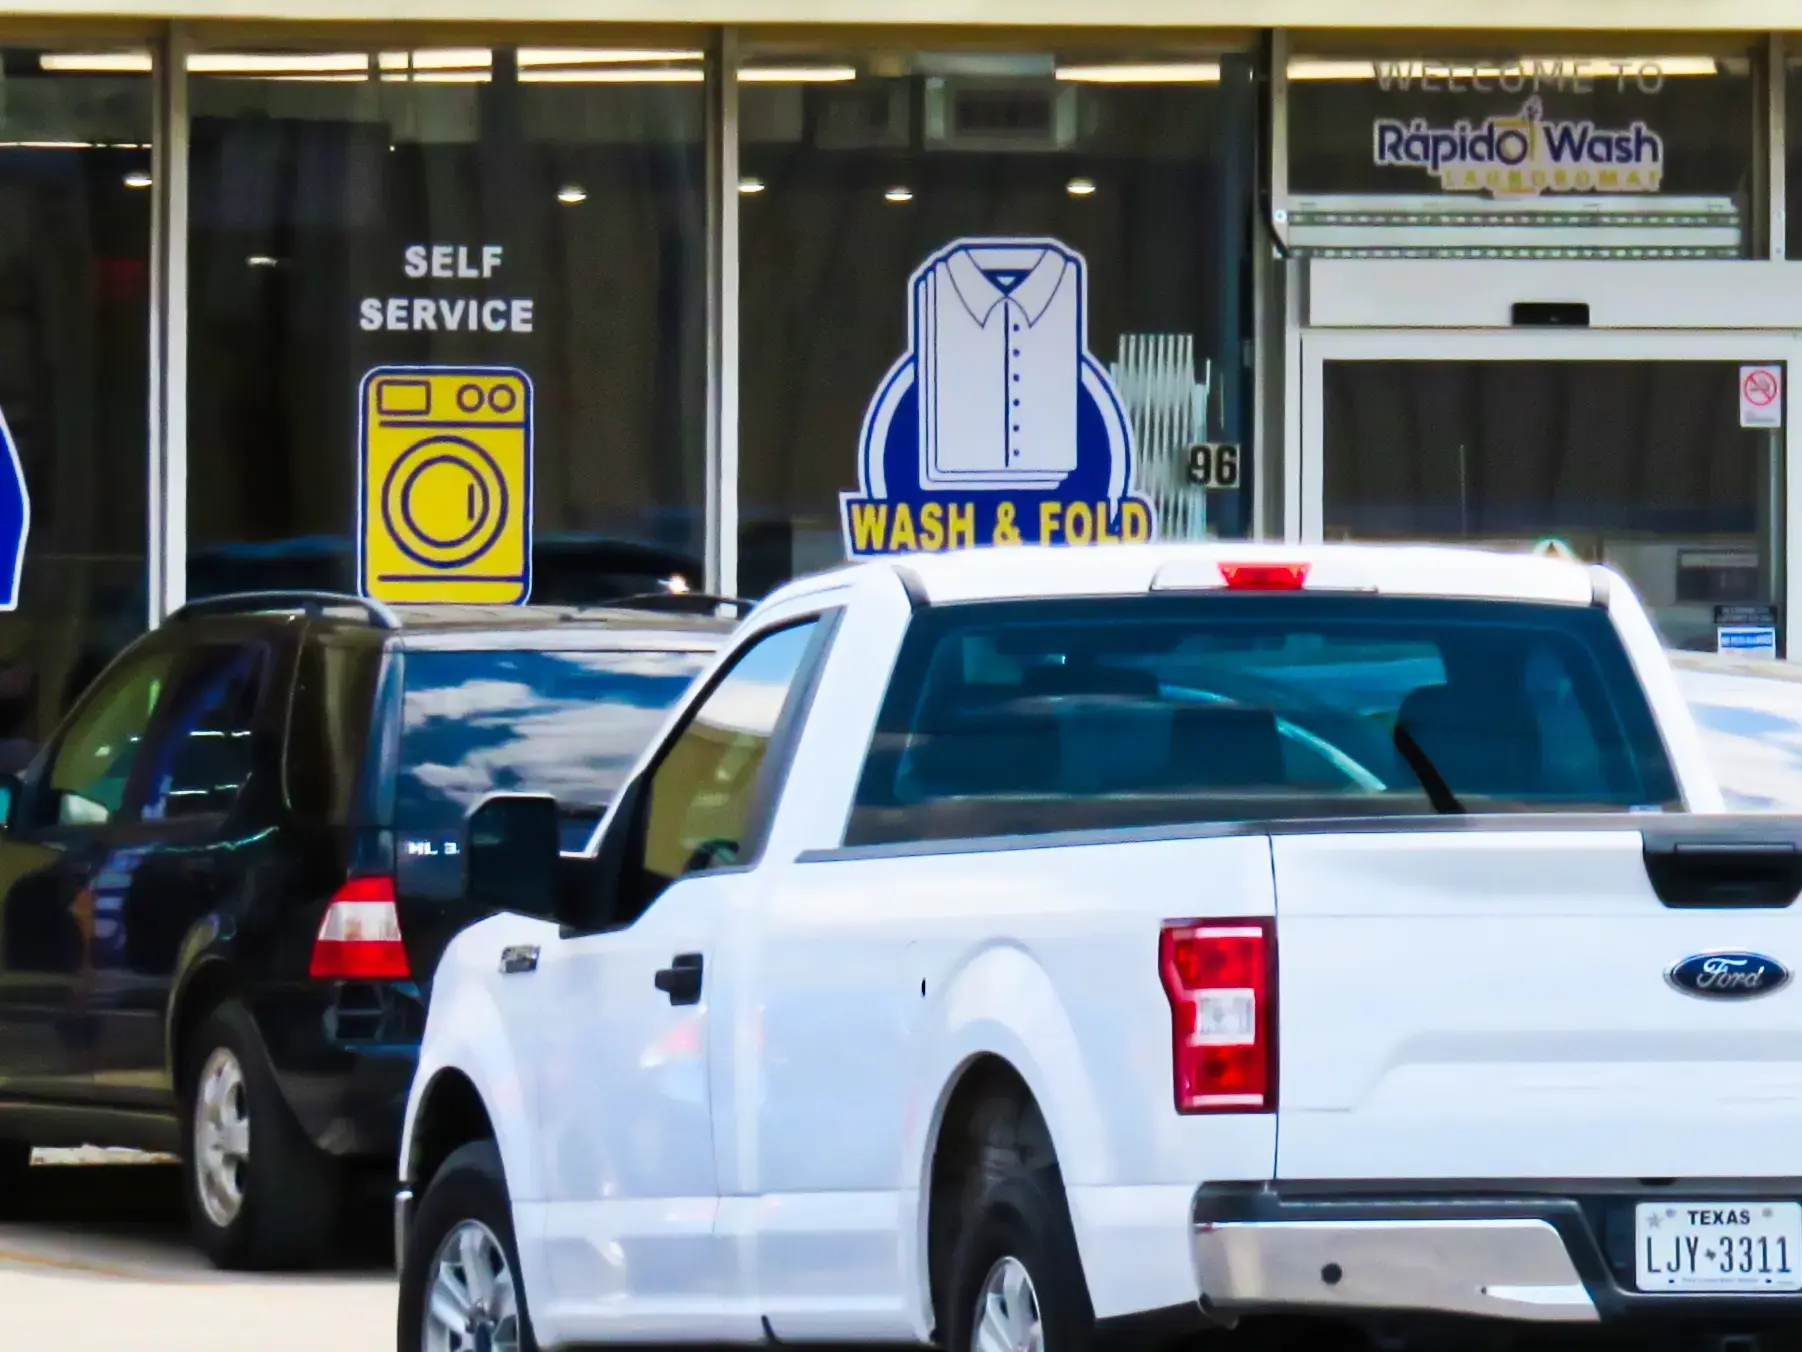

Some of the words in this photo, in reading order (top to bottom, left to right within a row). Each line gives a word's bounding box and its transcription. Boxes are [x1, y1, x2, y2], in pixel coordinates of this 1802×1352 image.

[1374, 60, 1593, 94] WELCOME
[1610, 61, 1663, 94] TO
[1543, 126, 1660, 165] Wash
[404, 245, 503, 278] SELF
[359, 297, 534, 333] SERVICE
[1187, 445, 1238, 486] 96
[850, 501, 975, 552] WASH
[993, 500, 1022, 548] &
[1039, 501, 1149, 548] FOLD
[1696, 957, 1765, 989] Ford
[1687, 1209, 1751, 1226] TEXAS
